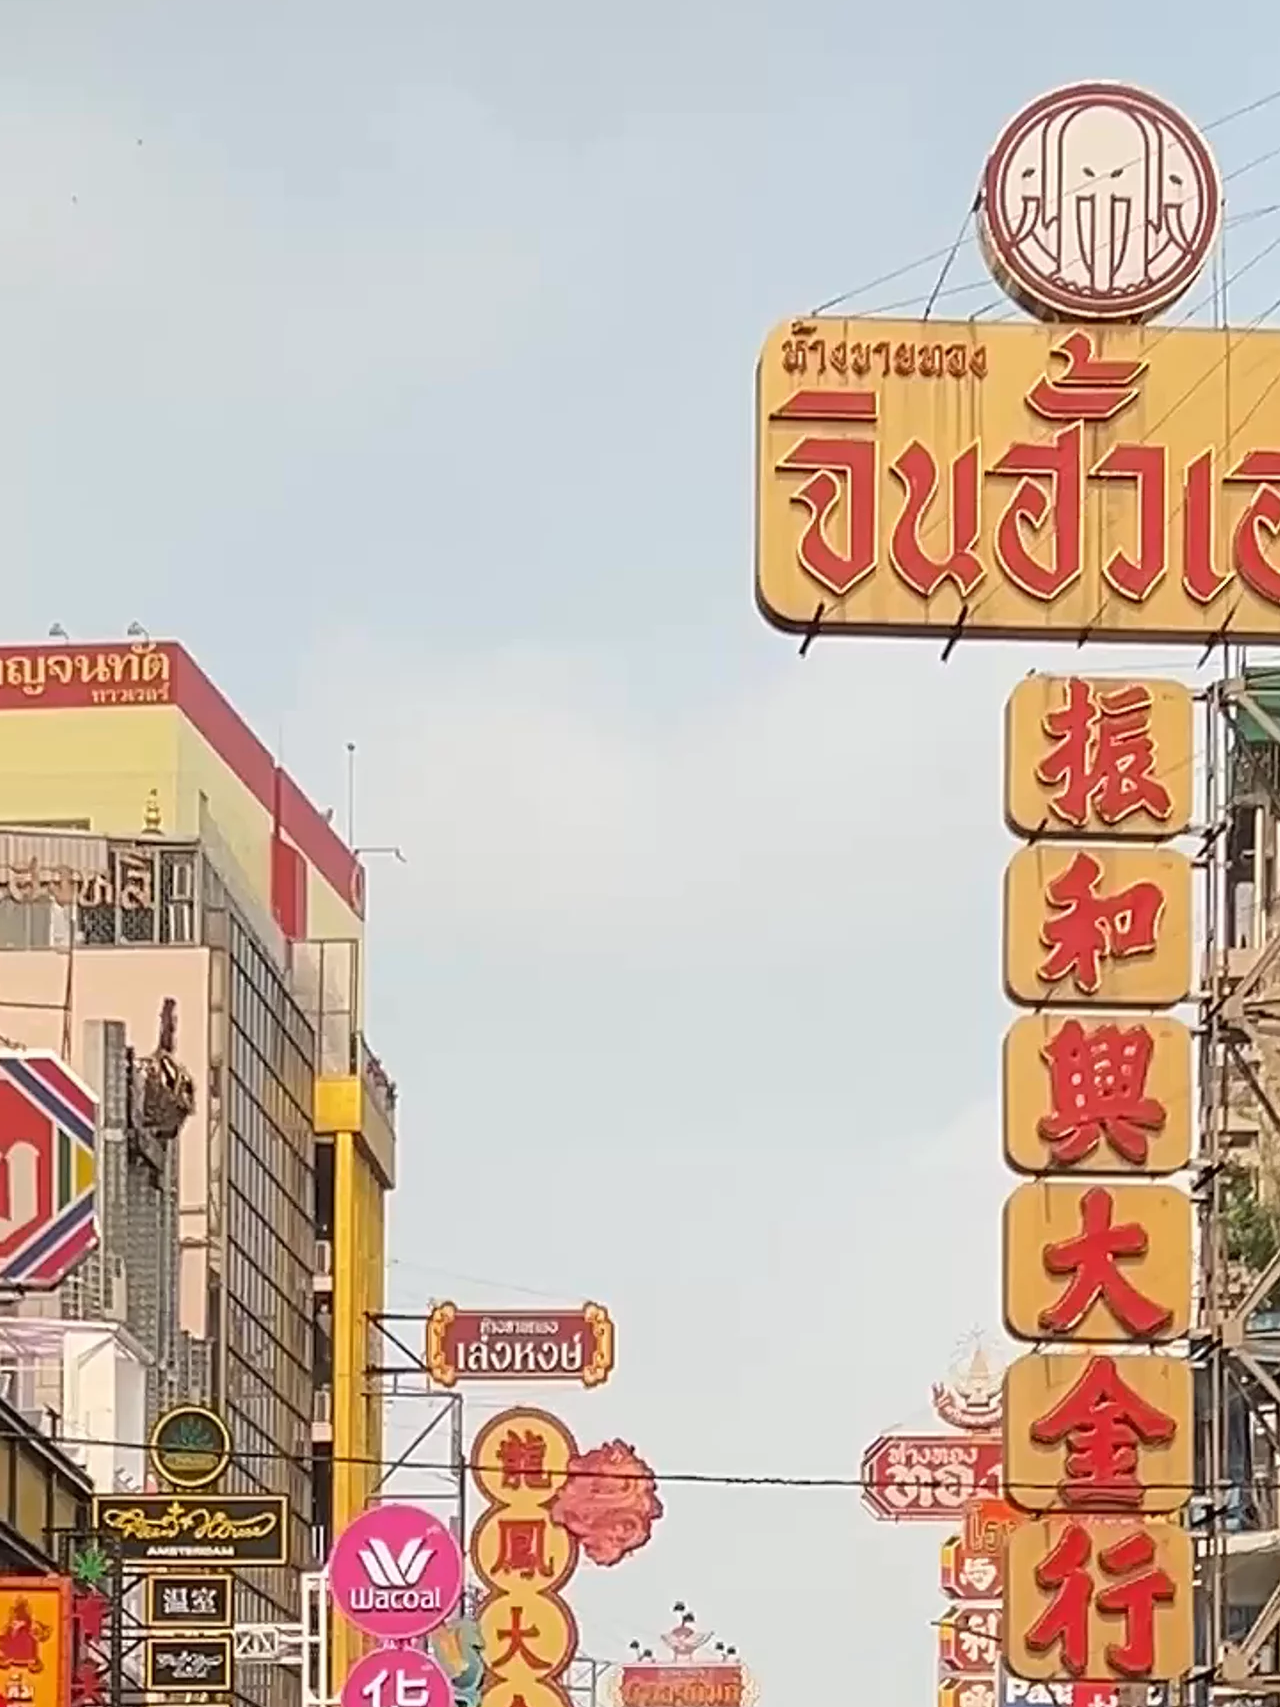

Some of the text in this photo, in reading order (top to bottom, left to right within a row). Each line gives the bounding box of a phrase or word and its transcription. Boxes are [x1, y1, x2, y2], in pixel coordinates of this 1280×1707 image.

[780, 325, 988, 377] ห้างขายทอง
[1028, 675, 1175, 1676] 振和興大金行
[456, 1332, 584, 1371] เล่งหงษ์
[146, 1544, 235, 1557] AMSTERDAM
[350, 1587, 442, 1610] Wacoal
